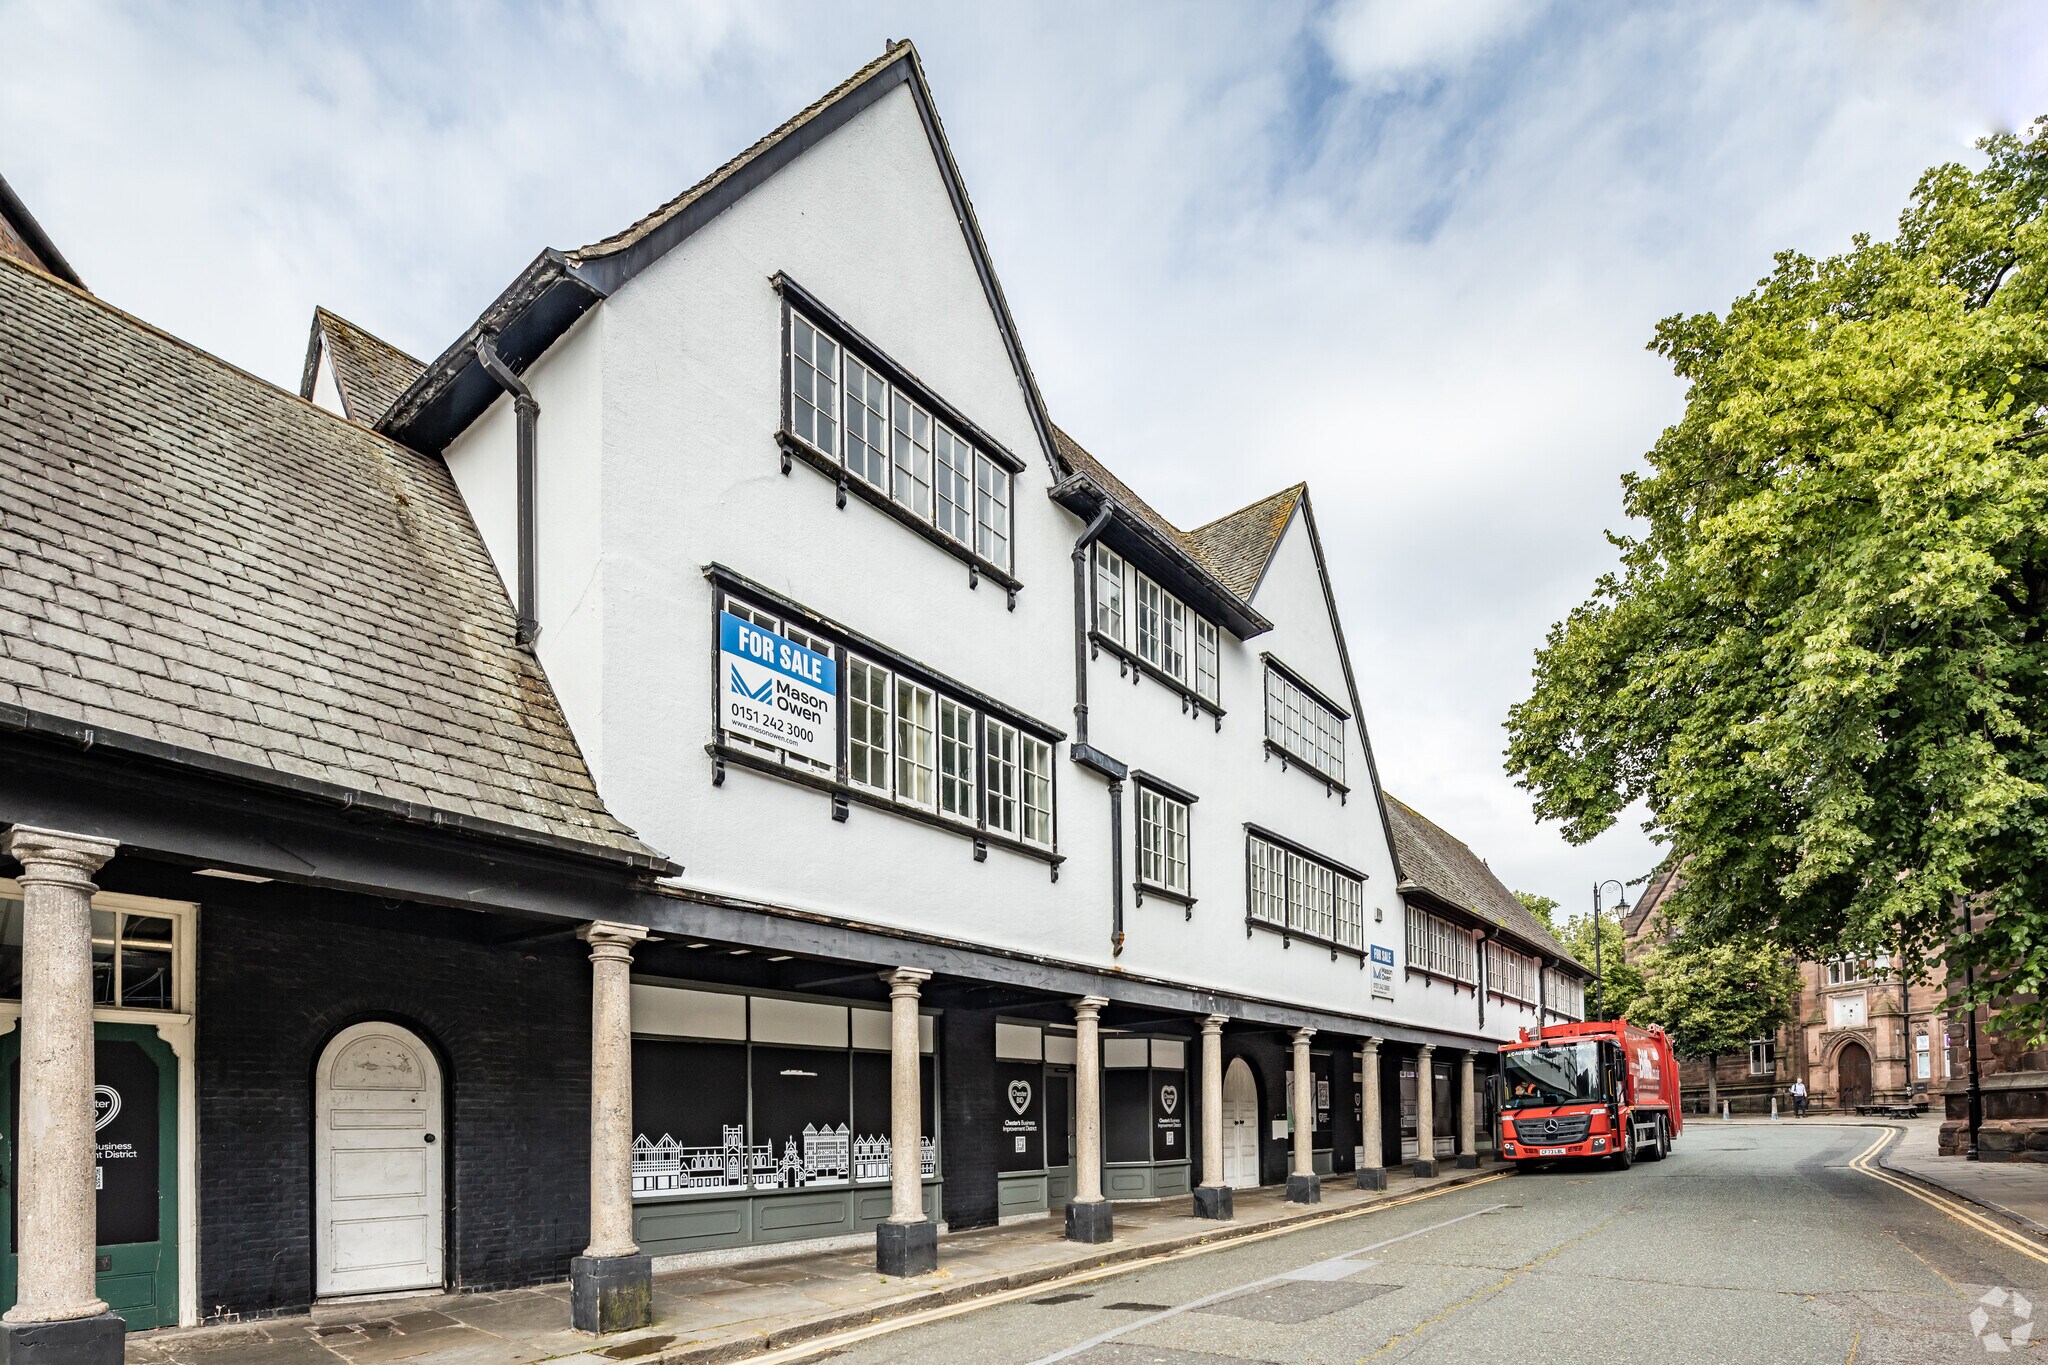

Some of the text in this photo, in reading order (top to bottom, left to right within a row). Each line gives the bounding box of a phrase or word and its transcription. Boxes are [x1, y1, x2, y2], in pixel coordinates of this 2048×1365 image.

[739, 625, 822, 684] FOR SALE
[776, 679, 828, 713] Mason
[776, 696, 822, 725] Owen
[731, 703, 814, 743] 0151 242 3000
[731, 719, 799, 747] www.masonowen.com
[104, 1150, 138, 1159] District
